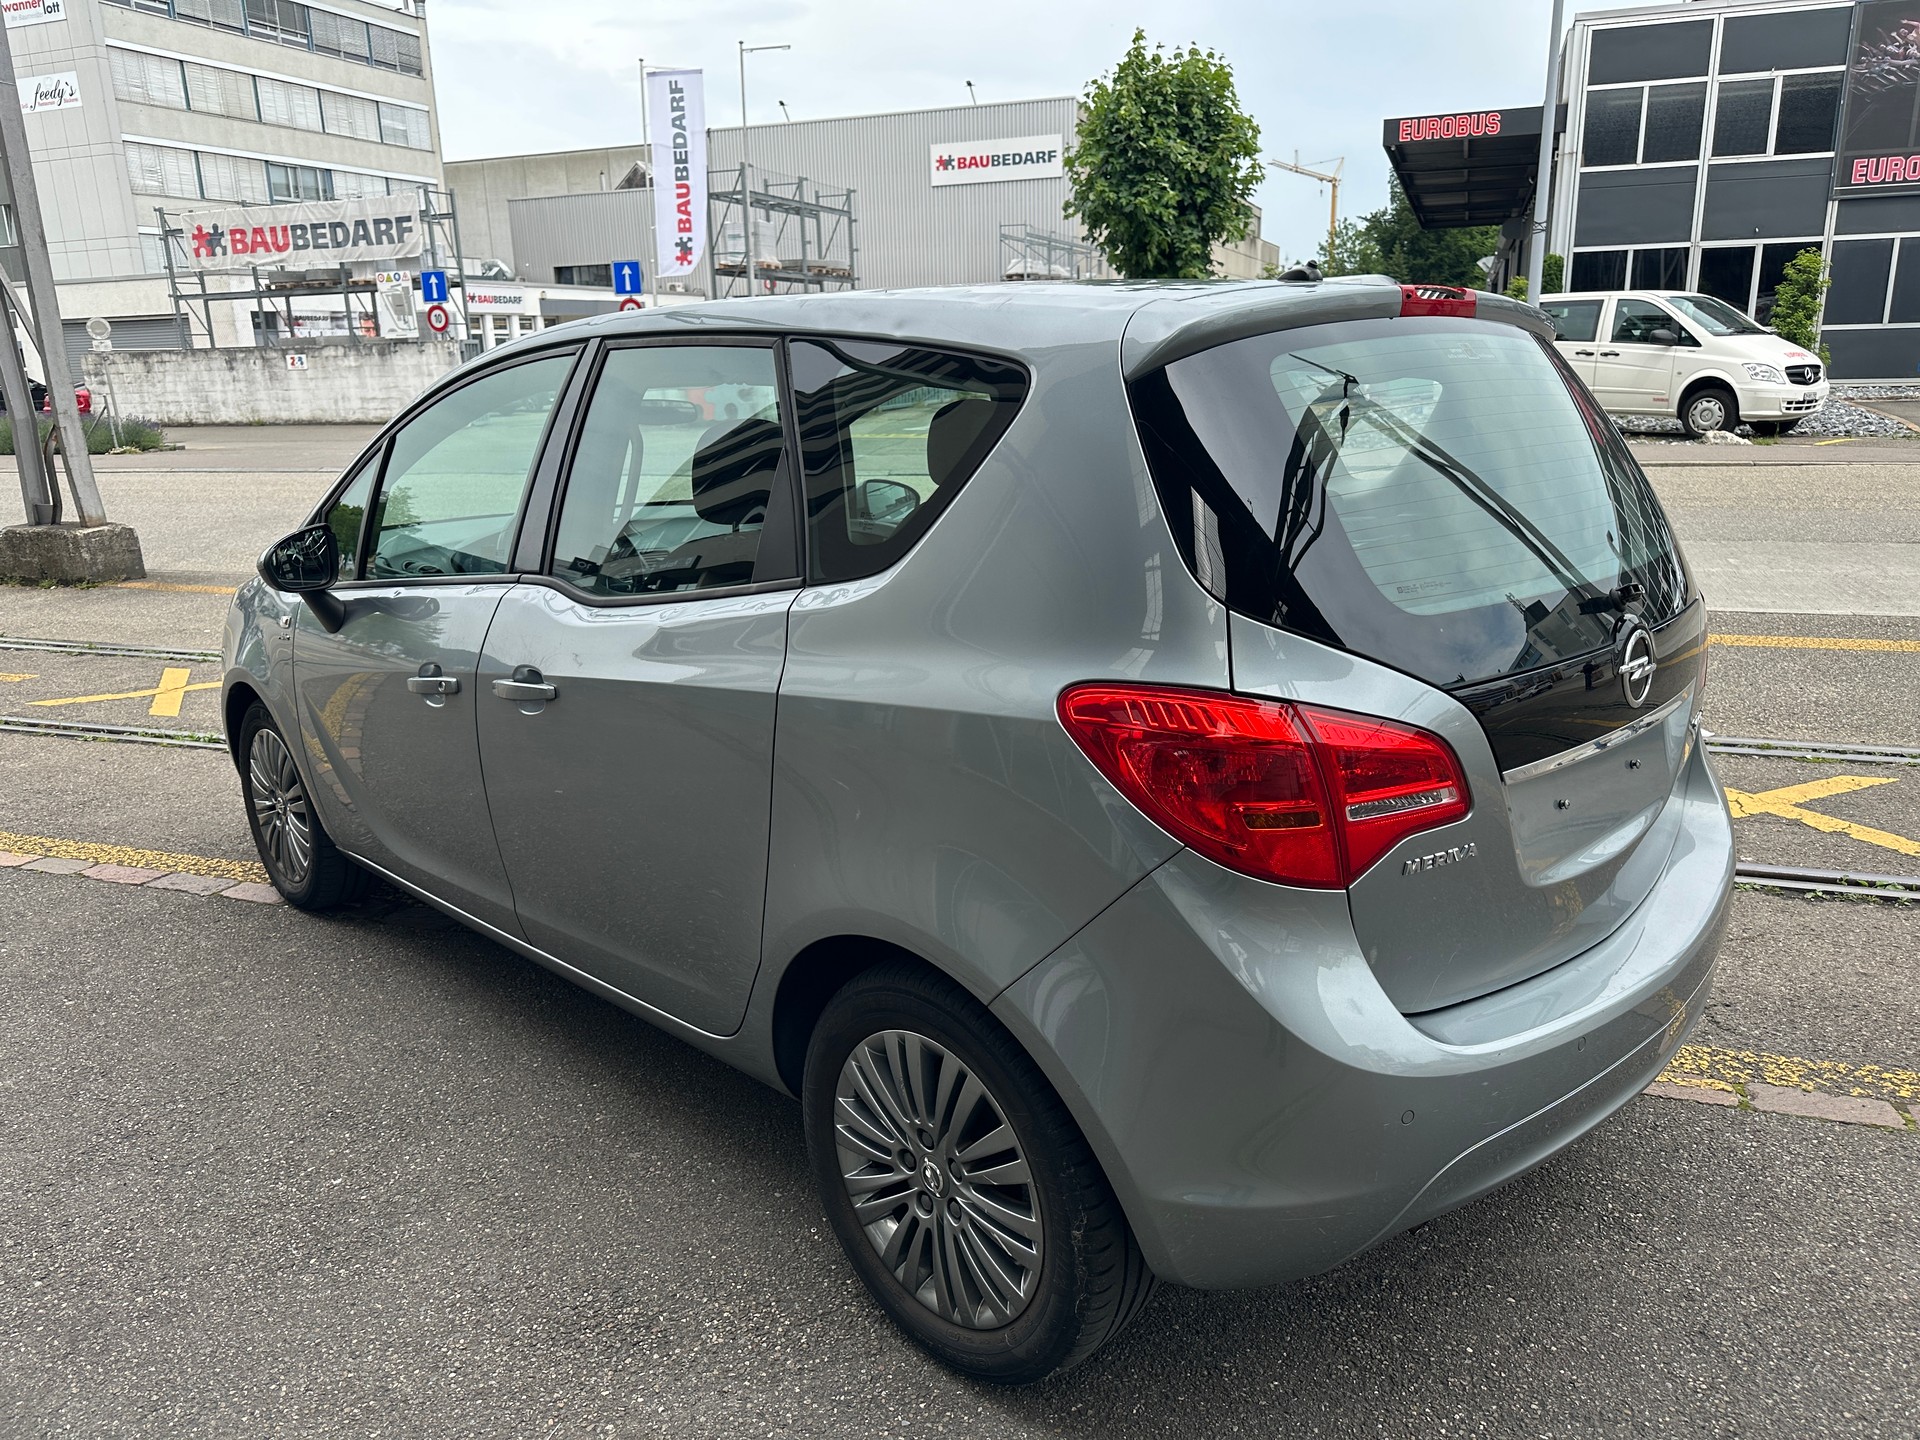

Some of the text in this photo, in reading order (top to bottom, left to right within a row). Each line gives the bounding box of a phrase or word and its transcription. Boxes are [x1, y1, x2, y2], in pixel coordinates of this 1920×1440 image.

[43, 0, 60, 15] lott
[1399, 112, 1501, 142] EUROBUS
[669, 80, 693, 233] BAUBEDARF
[957, 150, 1057, 170] BAUBEDARF
[1851, 155, 1920, 184] EURO
[229, 215, 413, 255] BAUBEDARF
[477, 295, 523, 305] BAUBEDARF
[434, 313, 443, 324] 10
[1402, 842, 1478, 876] MERIVA
